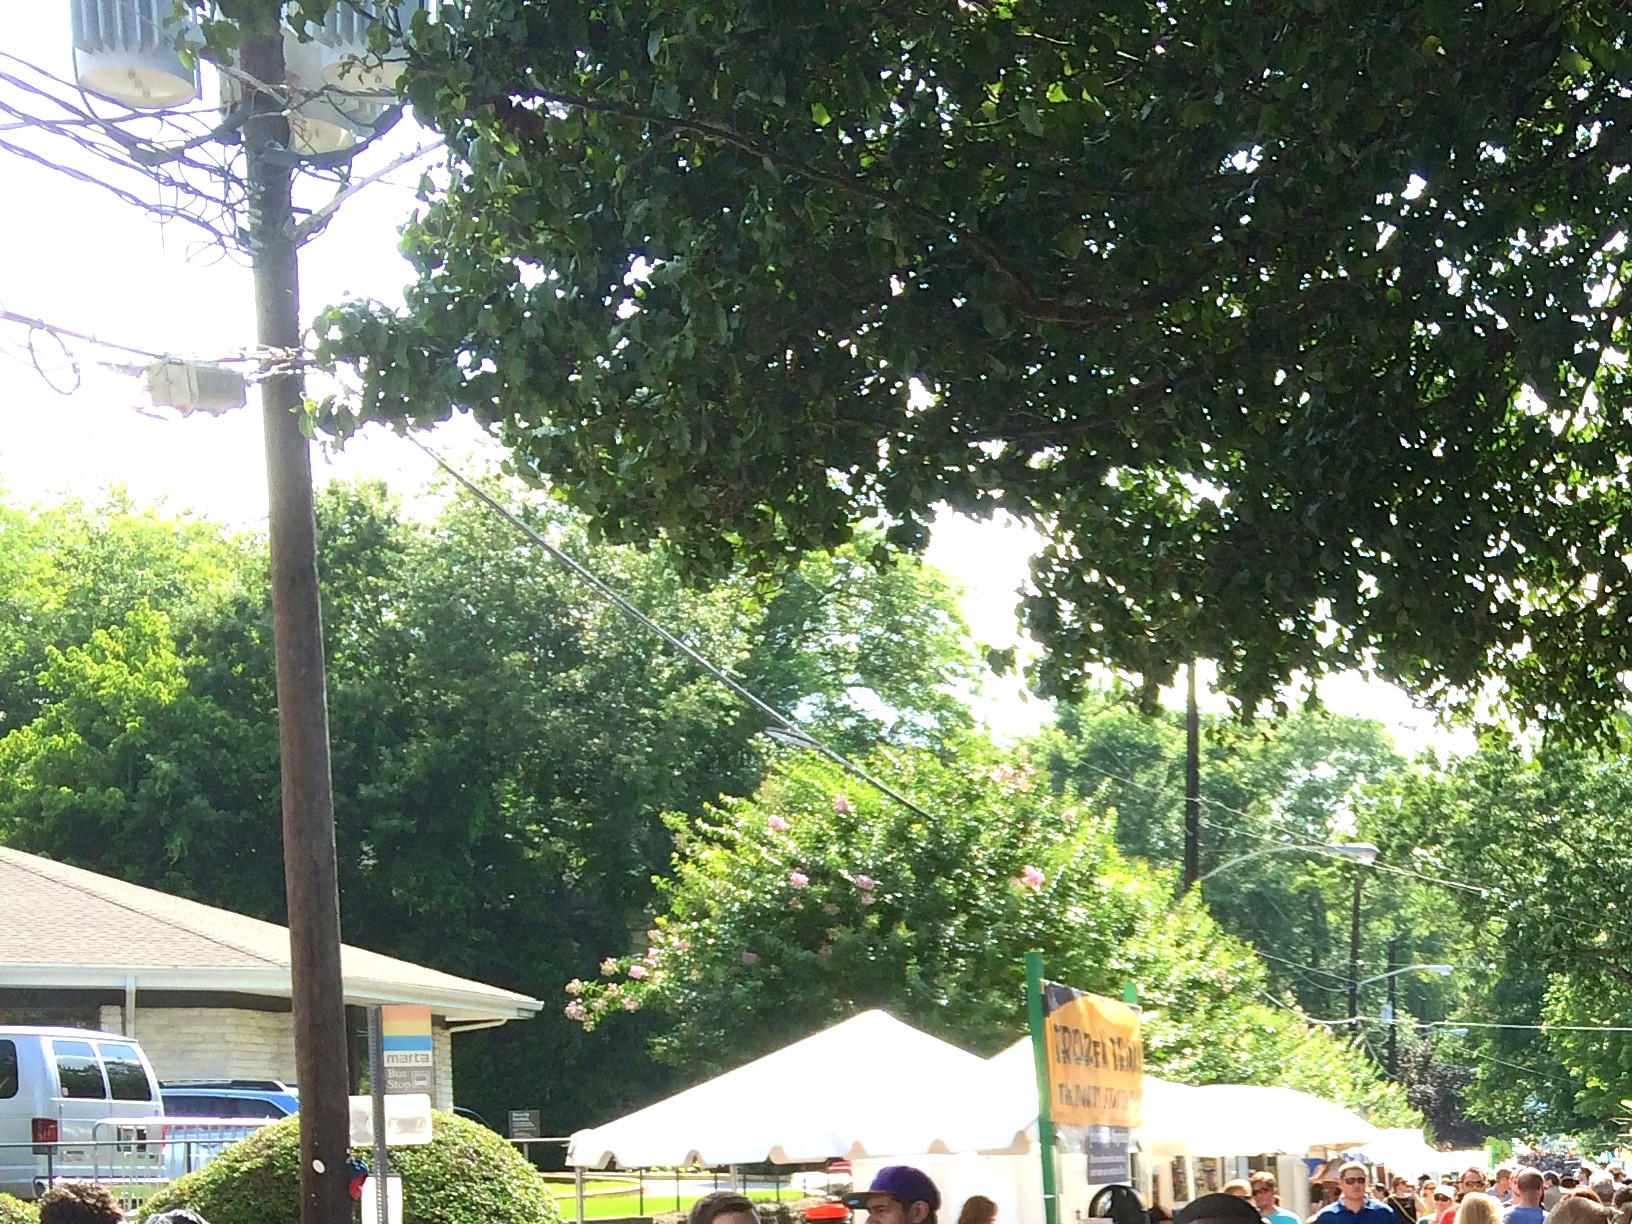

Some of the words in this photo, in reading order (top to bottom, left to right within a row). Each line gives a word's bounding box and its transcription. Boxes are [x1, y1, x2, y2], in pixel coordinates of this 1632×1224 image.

[386, 1053, 429, 1064] marta
[388, 1068, 408, 1079] Bus
[387, 1079, 412, 1091] Stop
